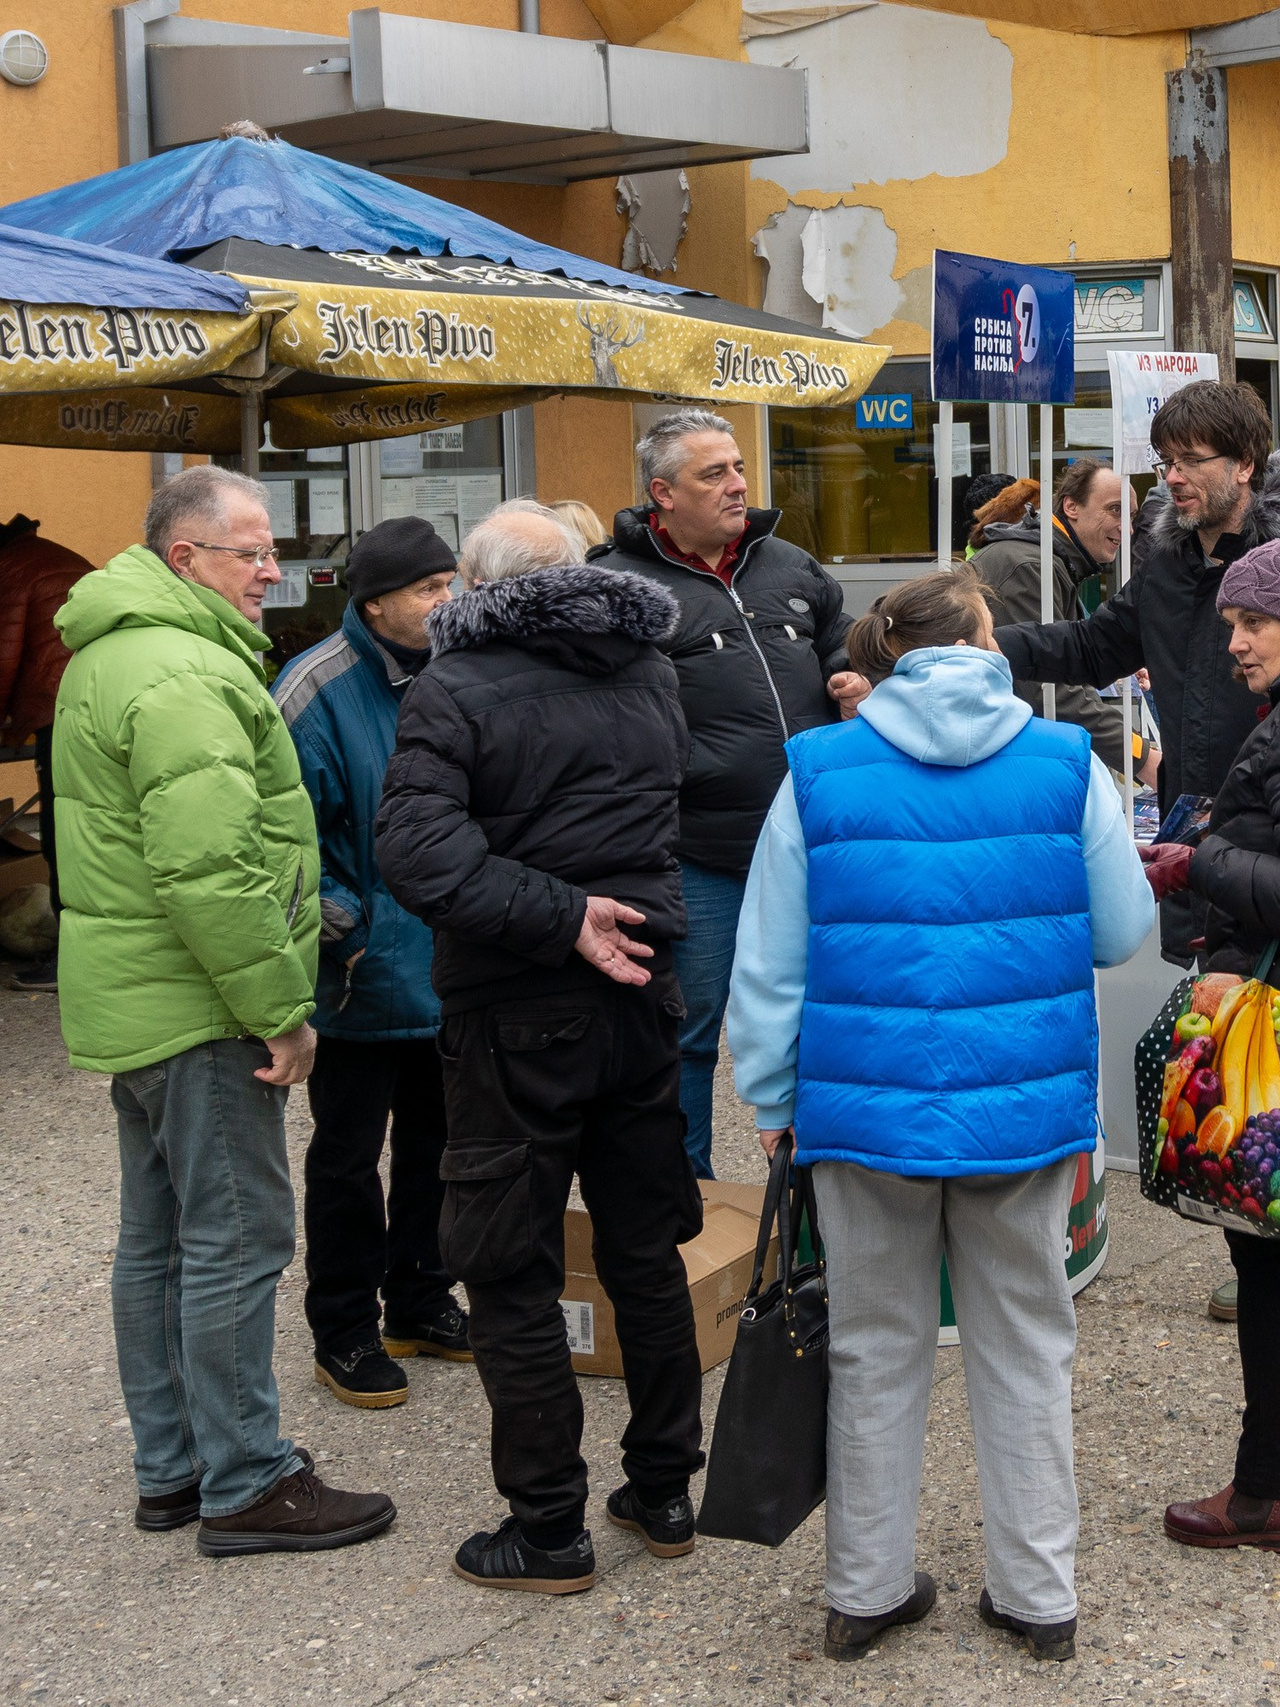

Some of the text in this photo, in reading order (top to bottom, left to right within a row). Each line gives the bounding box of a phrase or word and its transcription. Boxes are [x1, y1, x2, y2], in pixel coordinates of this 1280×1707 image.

[1234, 288, 1254, 328] C
[0, 303, 98, 364] elen
[317, 301, 494, 368] Jelen Pivo
[974, 317, 1013, 337] СРБИЈА
[1022, 302, 1036, 348] 7.
[974, 336, 1012, 355] ПРОТИВ
[710, 338, 849, 394] Jelen Pivo
[974, 354, 1014, 373] НАСИЉА
[1137, 354, 1198, 375] ИЗ НАРОДА
[861, 399, 908, 422] WC
